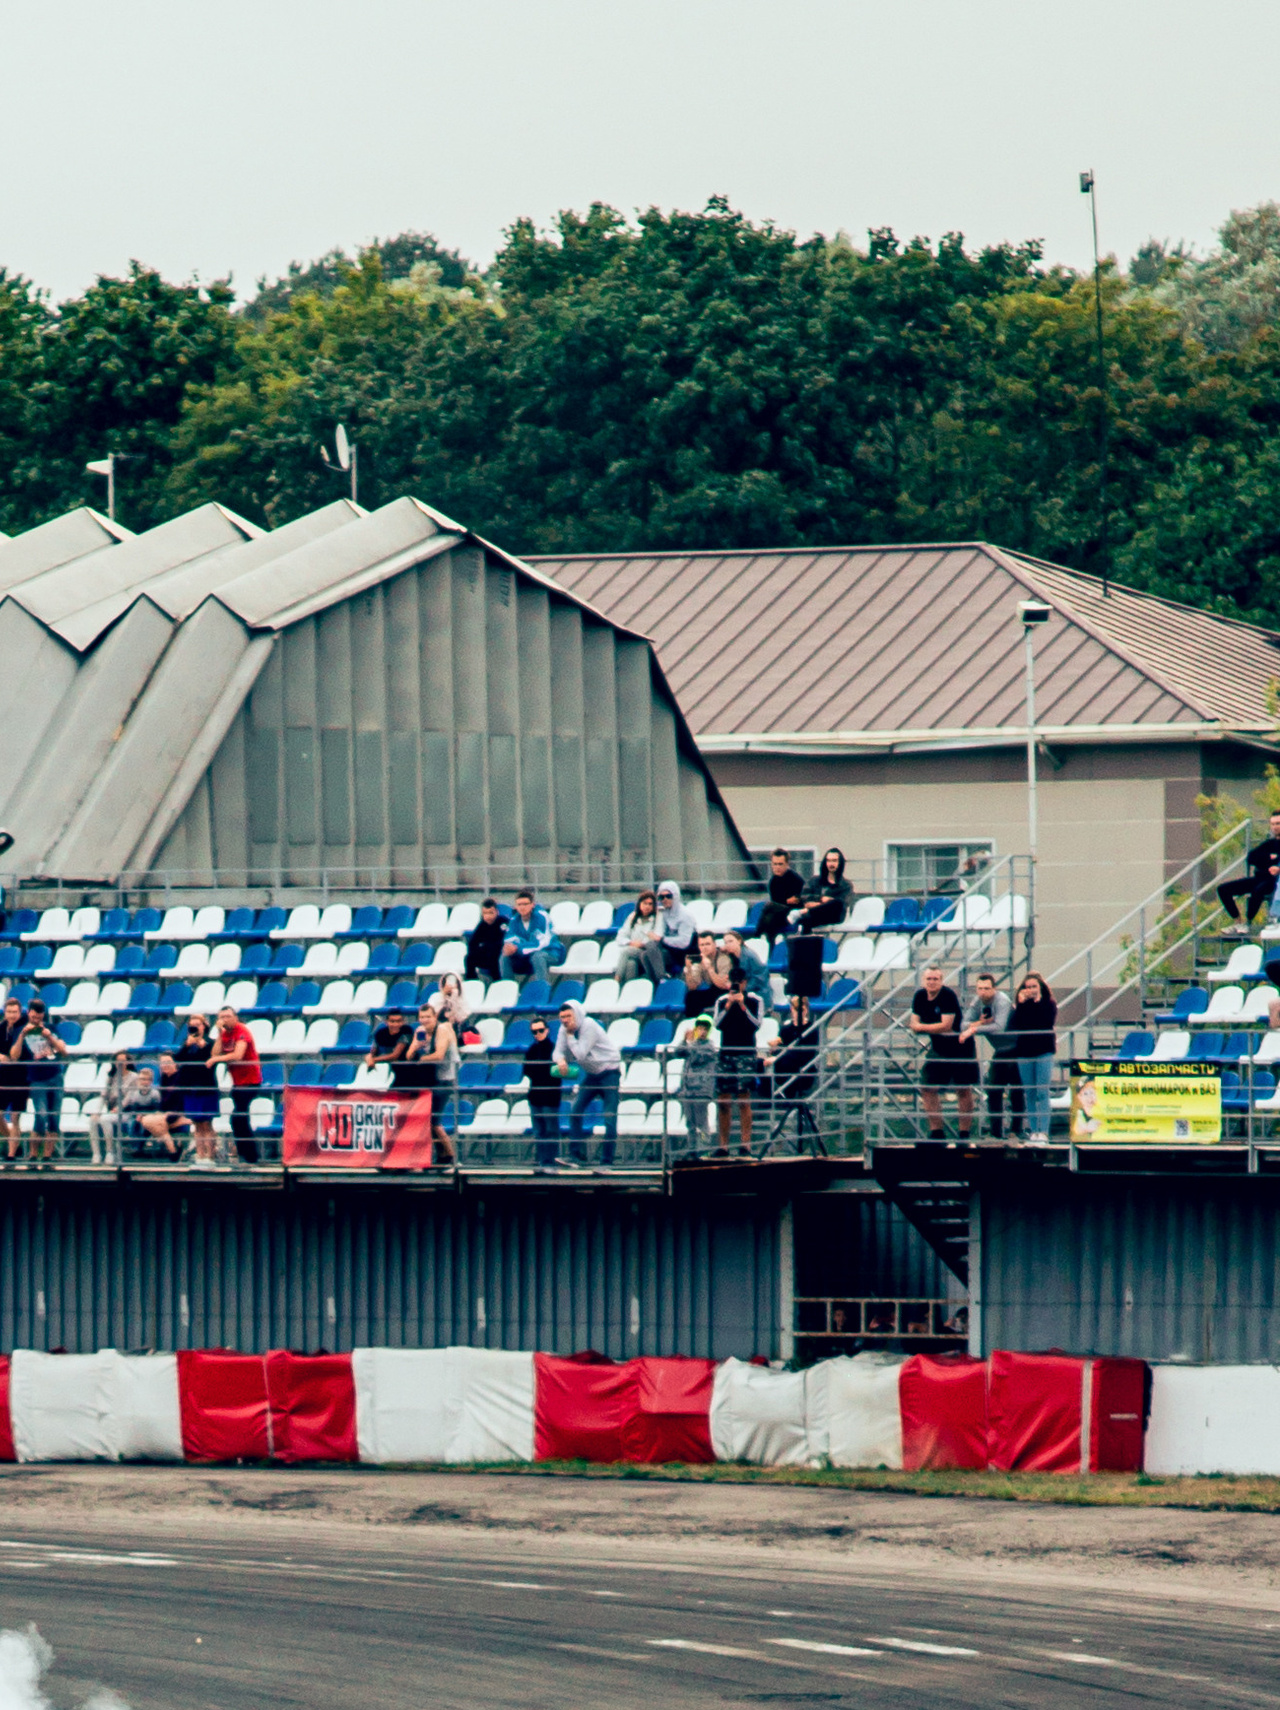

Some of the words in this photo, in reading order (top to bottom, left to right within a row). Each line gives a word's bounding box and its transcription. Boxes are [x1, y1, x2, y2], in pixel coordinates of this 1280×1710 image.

[320, 1103, 354, 1149] NO
[355, 1104, 397, 1127] DRIFT
[355, 1127, 384, 1150] FUN
